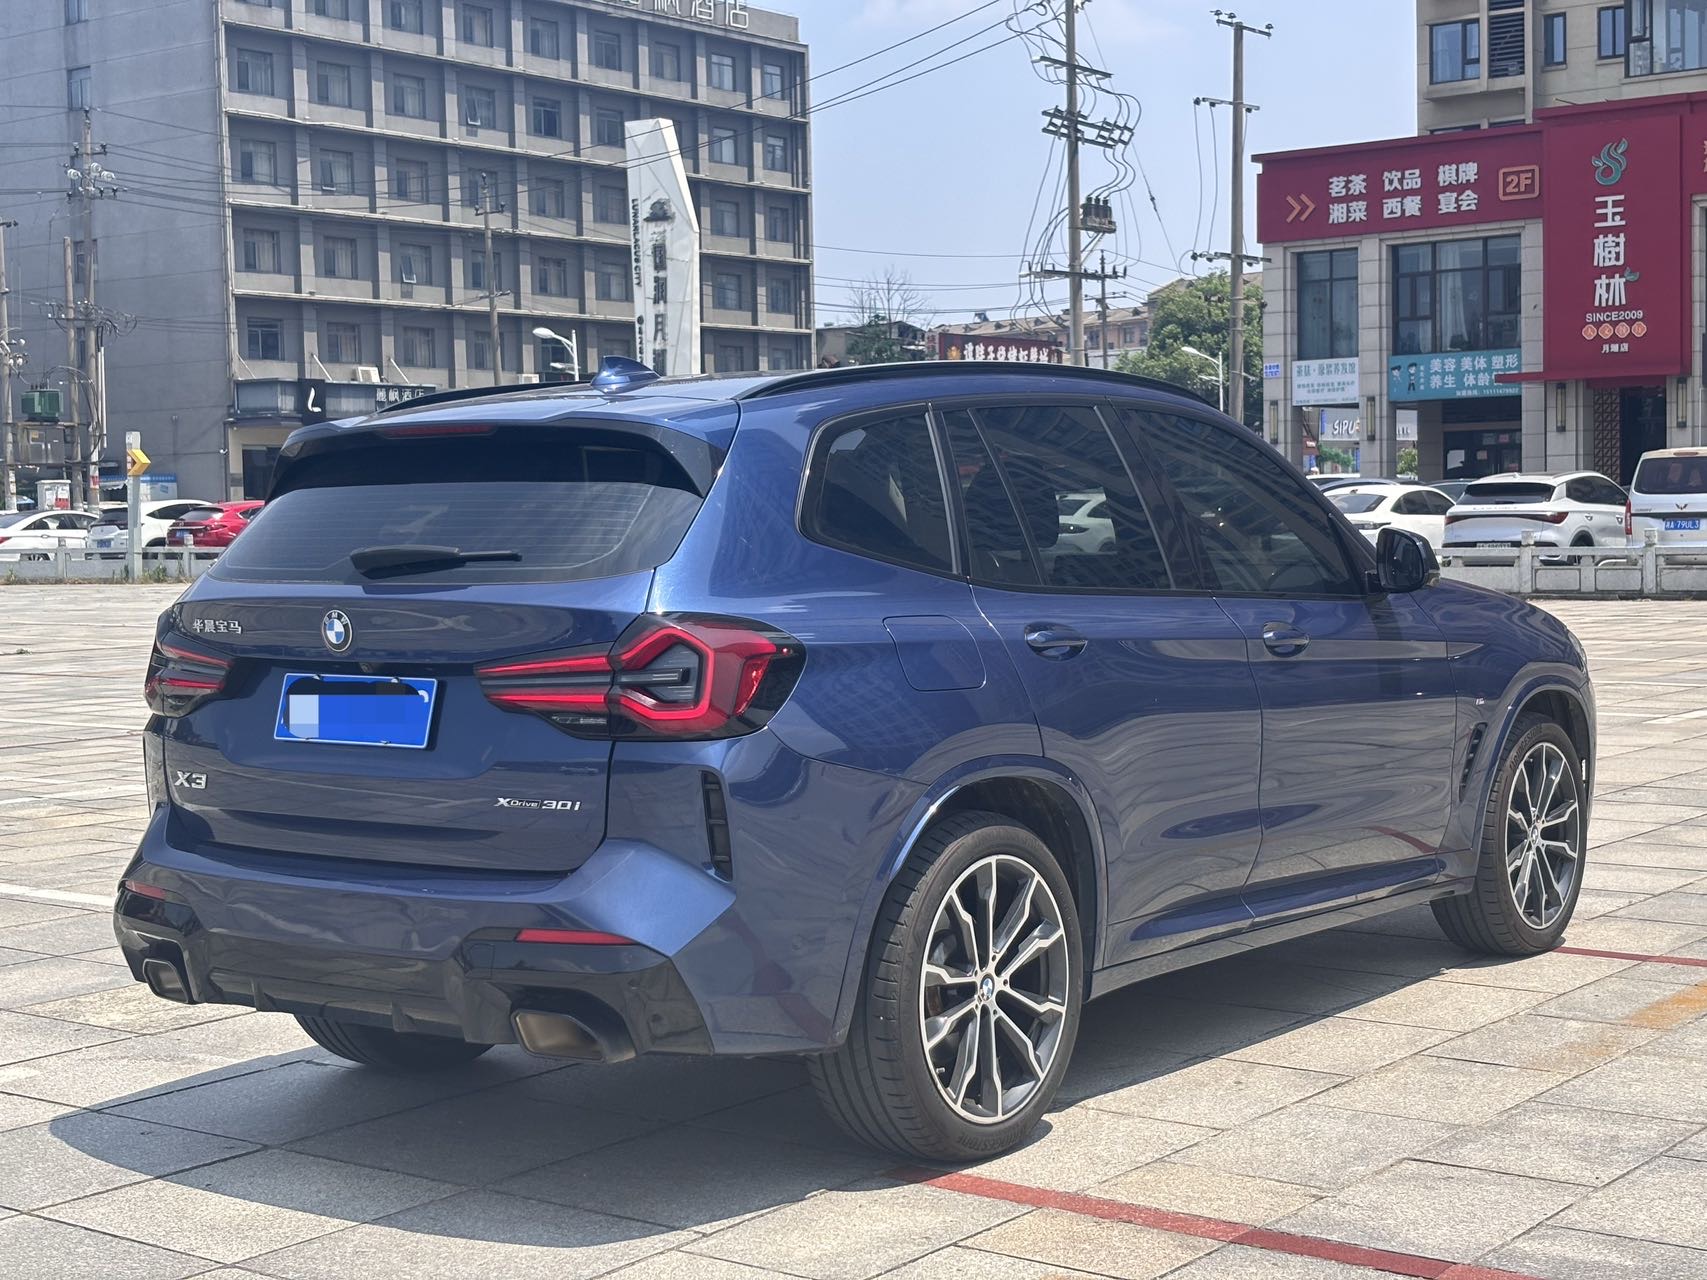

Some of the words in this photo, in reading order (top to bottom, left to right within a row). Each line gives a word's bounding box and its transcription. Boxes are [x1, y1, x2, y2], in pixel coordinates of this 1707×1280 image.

[1328, 174, 1367, 198] 茗茶
[1382, 169, 1421, 193] 饮品
[1437, 162, 1478, 187] 棋牌
[1505, 172, 1532, 193] 2F
[1328, 201, 1367, 224] 湘菜
[1382, 195, 1422, 219] 西餐
[1438, 190, 1478, 214] 宴会
[1593, 194, 1626, 307] 玉樹林
[634, 265, 643, 288] CITY
[1585, 310, 1643, 322] SINCE2009
[1430, 358, 1456, 373] 美容
[1460, 356, 1487, 371] 美体
[1491, 354, 1519, 369] 塑形
[1430, 374, 1456, 389] 养生
[192, 619, 242, 634] 华晨宝马
[174, 771, 207, 789] X3
